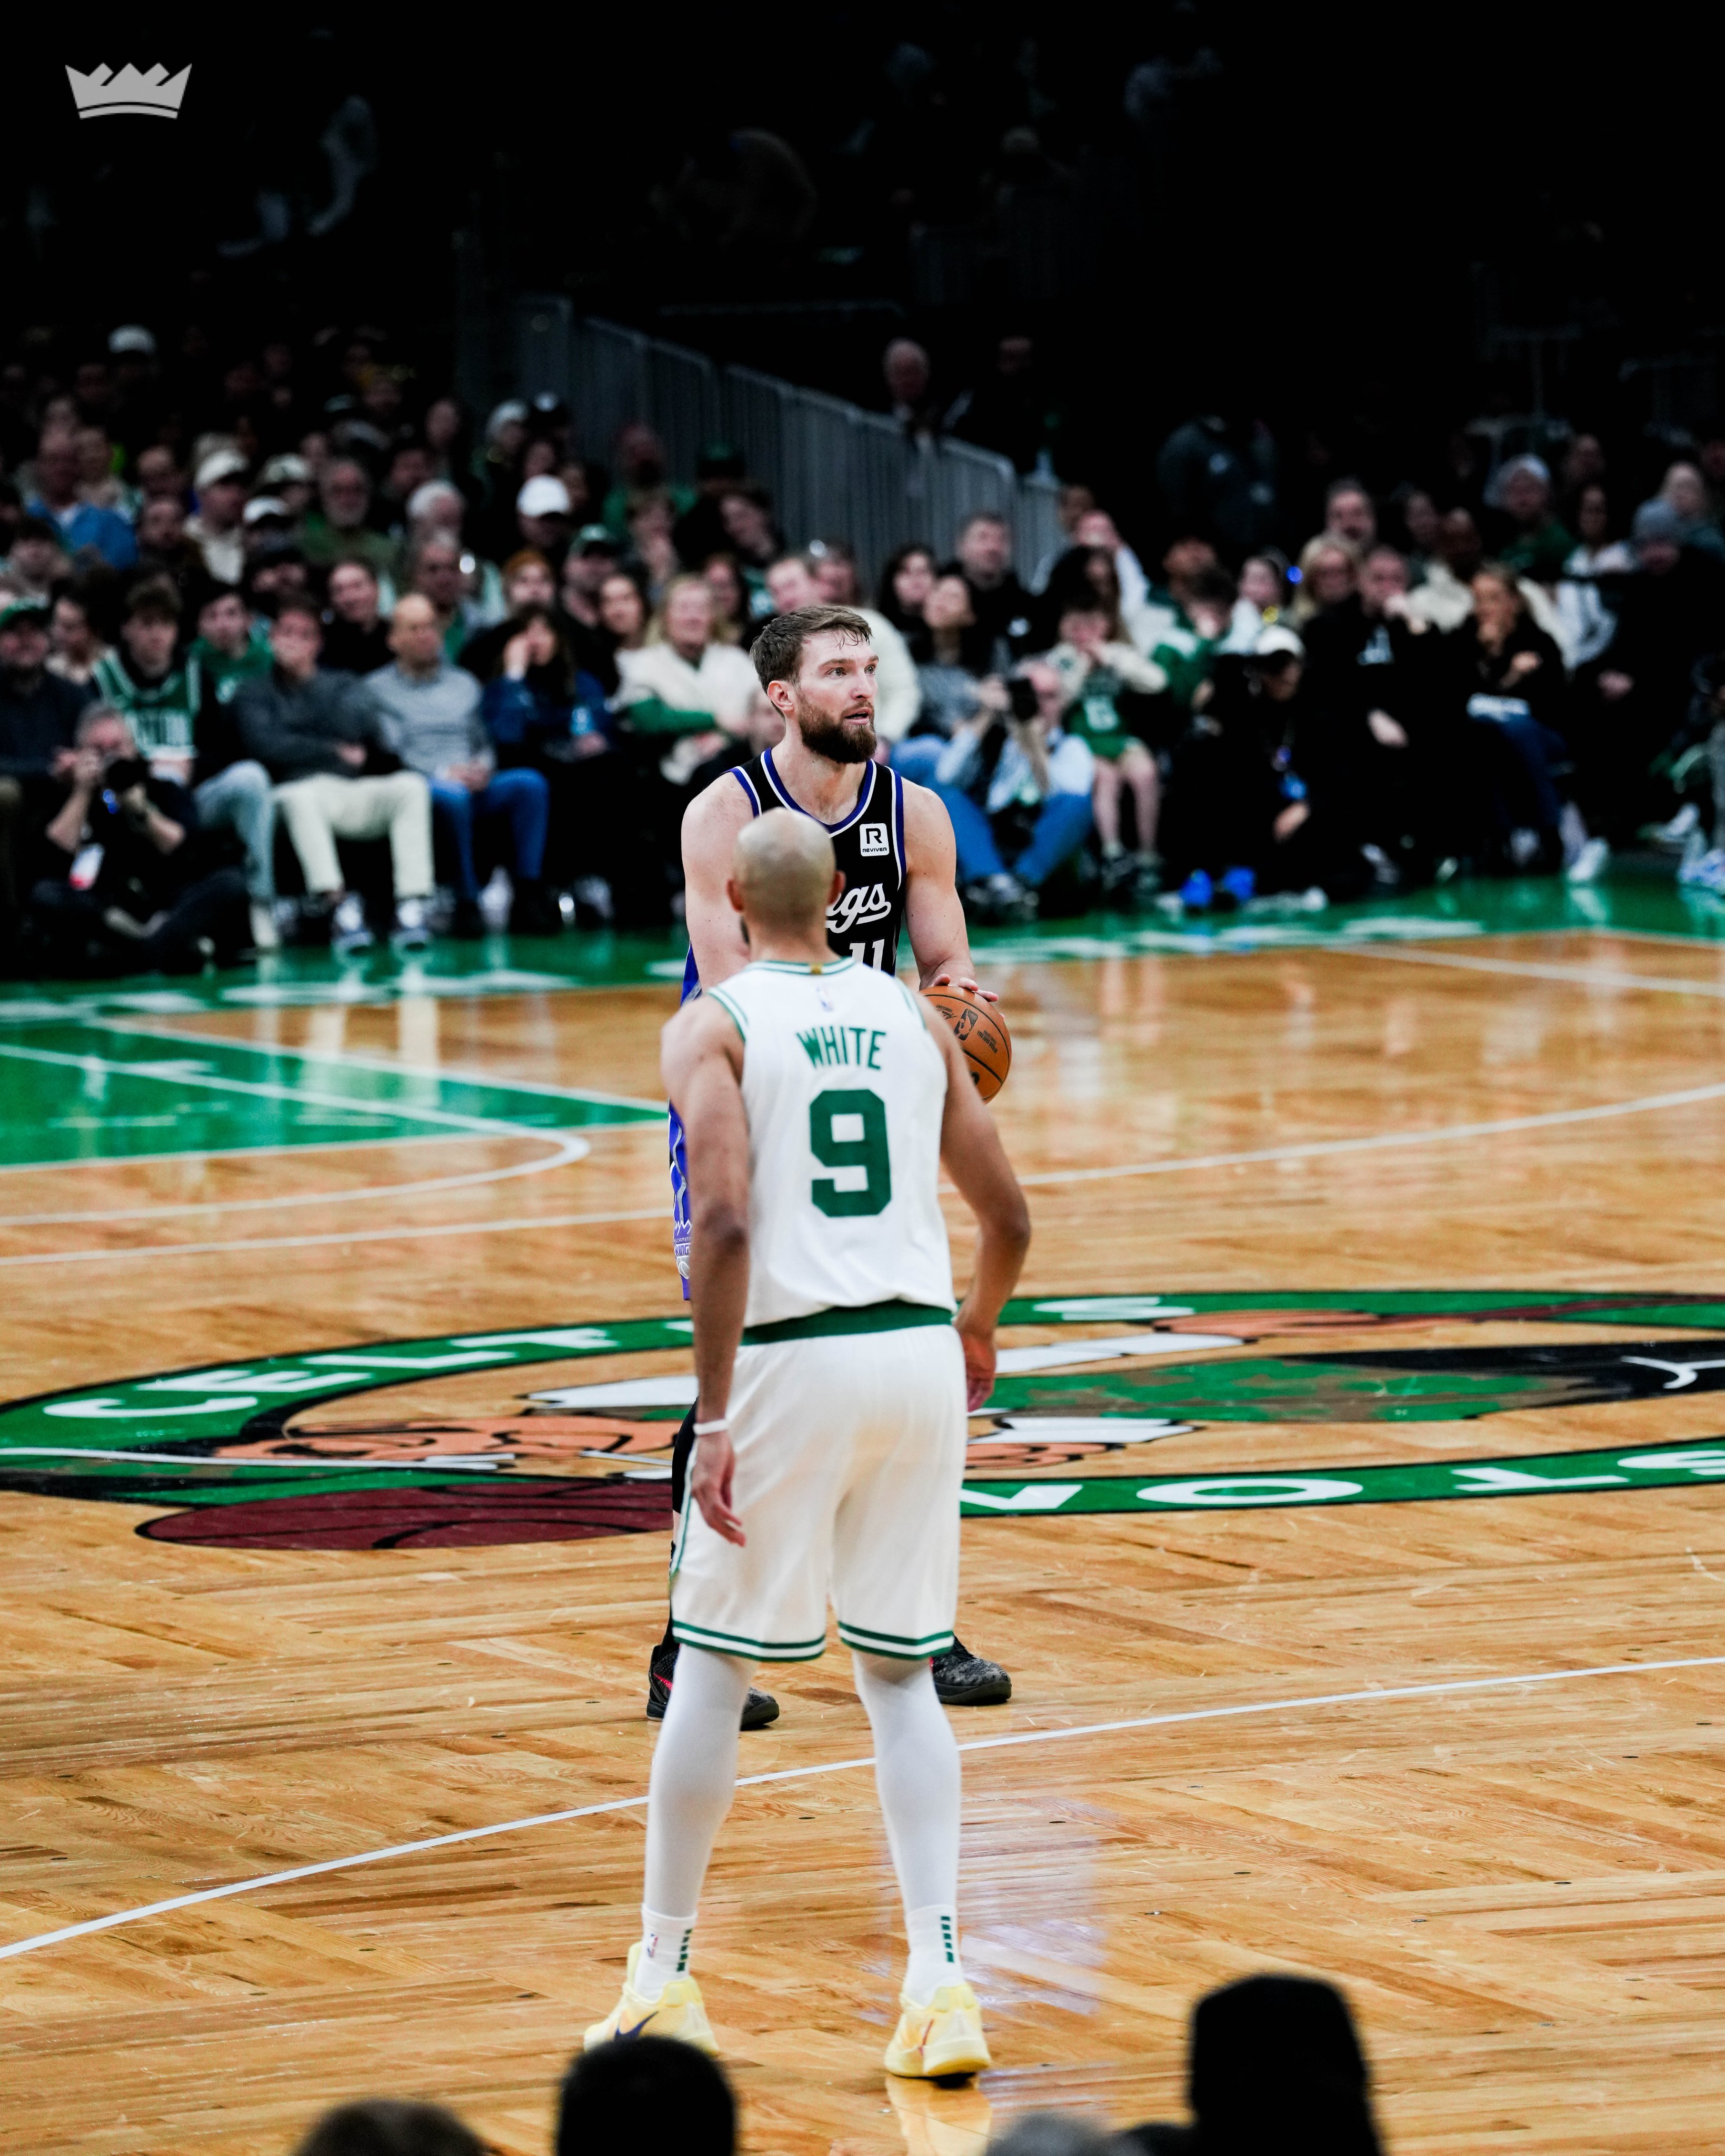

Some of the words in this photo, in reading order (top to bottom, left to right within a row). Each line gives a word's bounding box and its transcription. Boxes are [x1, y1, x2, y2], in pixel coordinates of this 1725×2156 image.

[865, 827, 883, 844] R
[796, 1026, 887, 1070] WHITE
[809, 1089, 892, 1217] 9
[675, 1244, 691, 1257] KING
